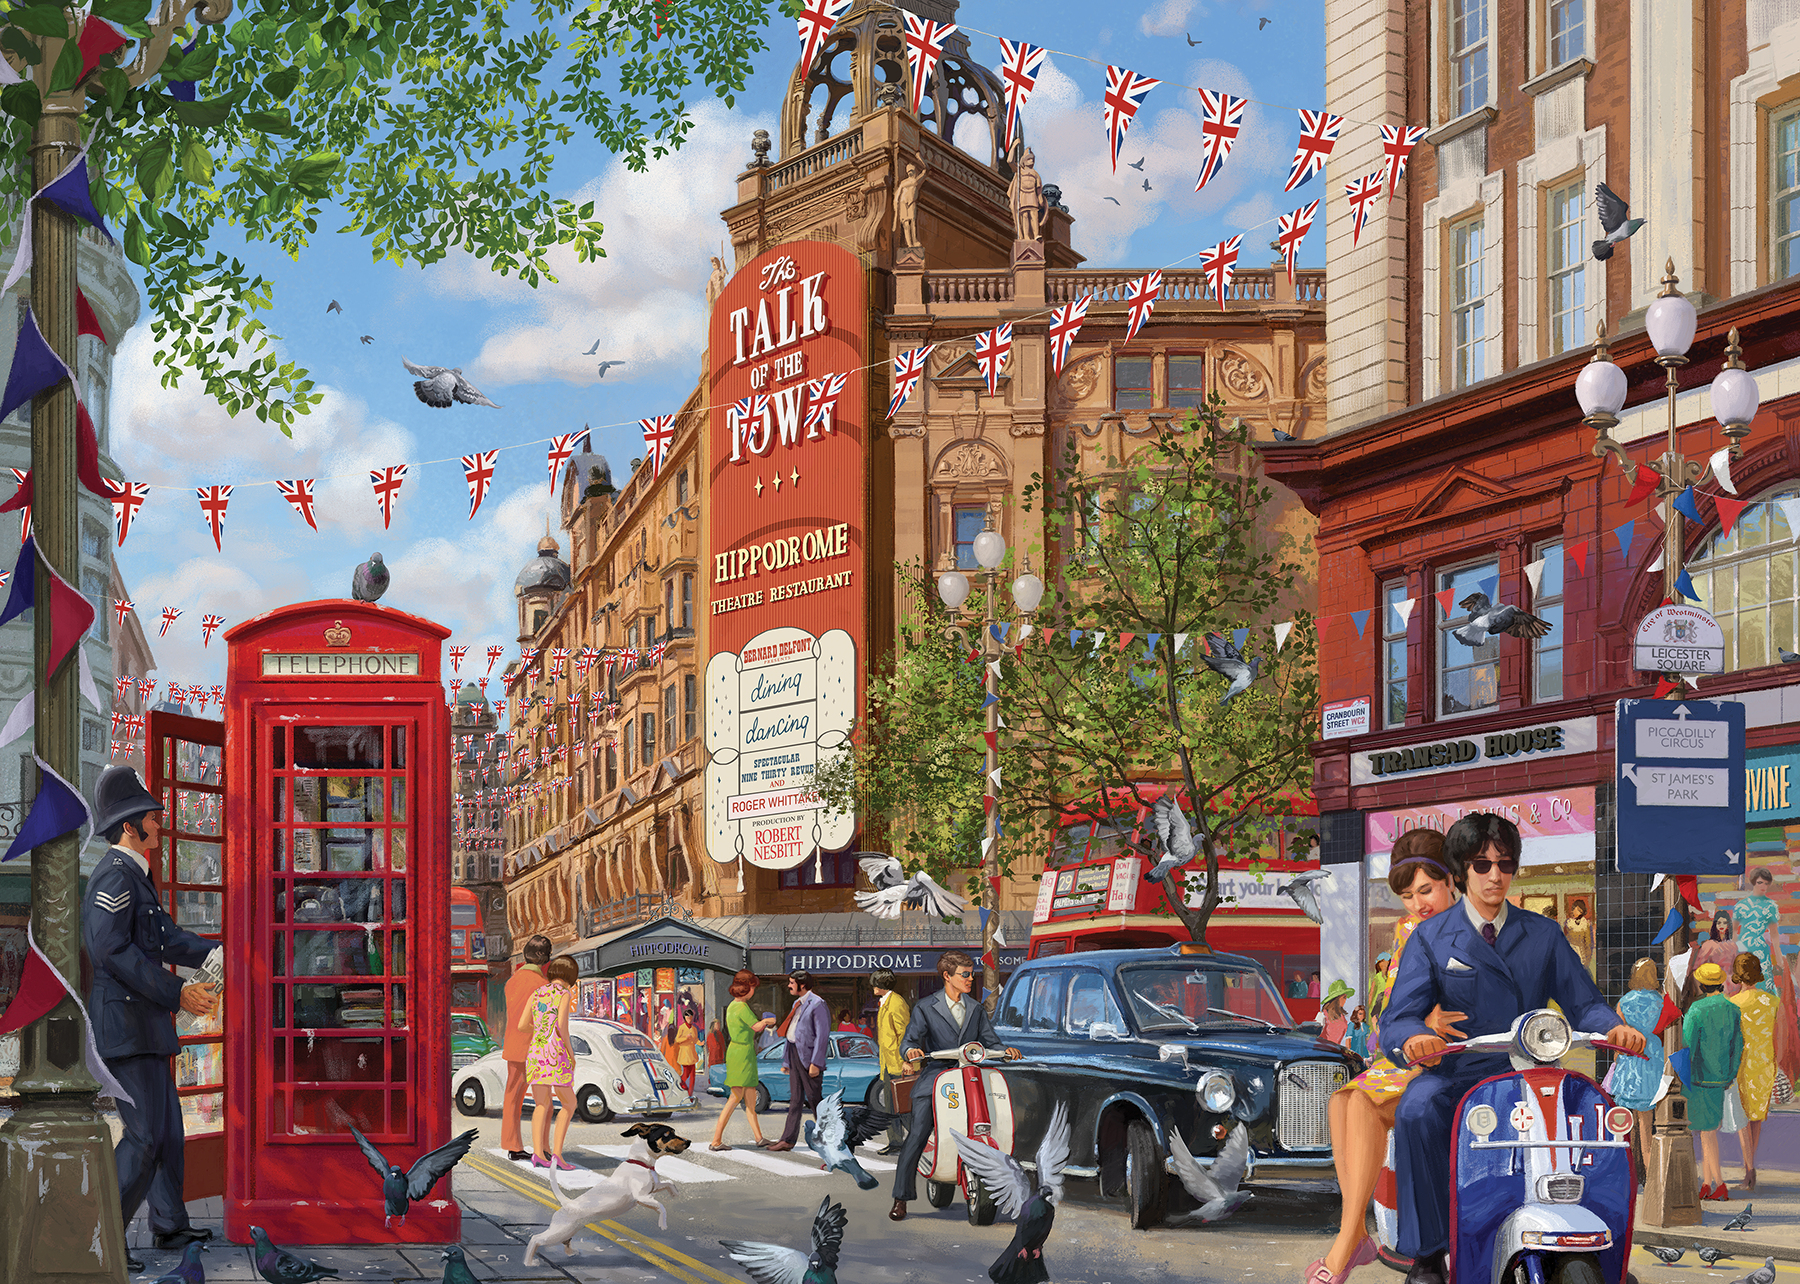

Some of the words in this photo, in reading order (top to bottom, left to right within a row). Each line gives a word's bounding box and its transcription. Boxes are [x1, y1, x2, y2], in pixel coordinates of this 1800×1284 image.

[759, 255, 796, 290] The
[730, 271, 826, 365] TALK
[751, 364, 768, 389] OF
[775, 351, 803, 382] THE
[715, 523, 848, 583] HIPPODROME
[711, 590, 763, 615] THEATRE
[770, 571, 852, 603] RESTAURANT
[1667, 608, 1715, 628] Westminster
[743, 644, 778, 663] BERNARD
[779, 637, 812, 656] DELFONT
[1651, 648, 1711, 660] LEICESTER
[272, 655, 411, 675] TELEPHONE
[1657, 660, 1706, 671] SQUARE
[750, 672, 802, 702] dining
[1326, 708, 1365, 721] CRANBOURN
[1326, 719, 1350, 729] STREET
[1351, 716, 1365, 725] WC2
[745, 714, 809, 744] dancing
[1648, 727, 1717, 739] PICCADILLY
[1368, 740, 1477, 776] TRANSAD
[1484, 726, 1563, 758] HOUSE
[1661, 738, 1704, 749] CIRCUS
[754, 753, 800, 769] SPECTACULAR
[741, 772, 757, 783] NINE
[761, 767, 787, 780] THIRTY
[791, 764, 814, 776] REVUE
[1651, 773, 1666, 784] ST
[1668, 773, 1715, 786] JAMES'S
[769, 780, 785, 788] AND
[1745, 764, 1790, 811] VINE
[1668, 788, 1699, 800] PARK
[732, 798, 765, 813] ROGER
[752, 816, 796, 827] PRODUCTION
[797, 814, 806, 822] BY
[1387, 812, 1445, 842] JOHN
[1529, 802, 1541, 824] &
[755, 826, 802, 845] ROBERT
[754, 842, 803, 861] NESBITT
[1057, 875, 1073, 892] 29
[1240, 881, 1274, 899] your
[1112, 890, 1134, 905] Haig
[629, 941, 710, 957] HIPPODROME
[791, 954, 922, 970] HIPPODROME
